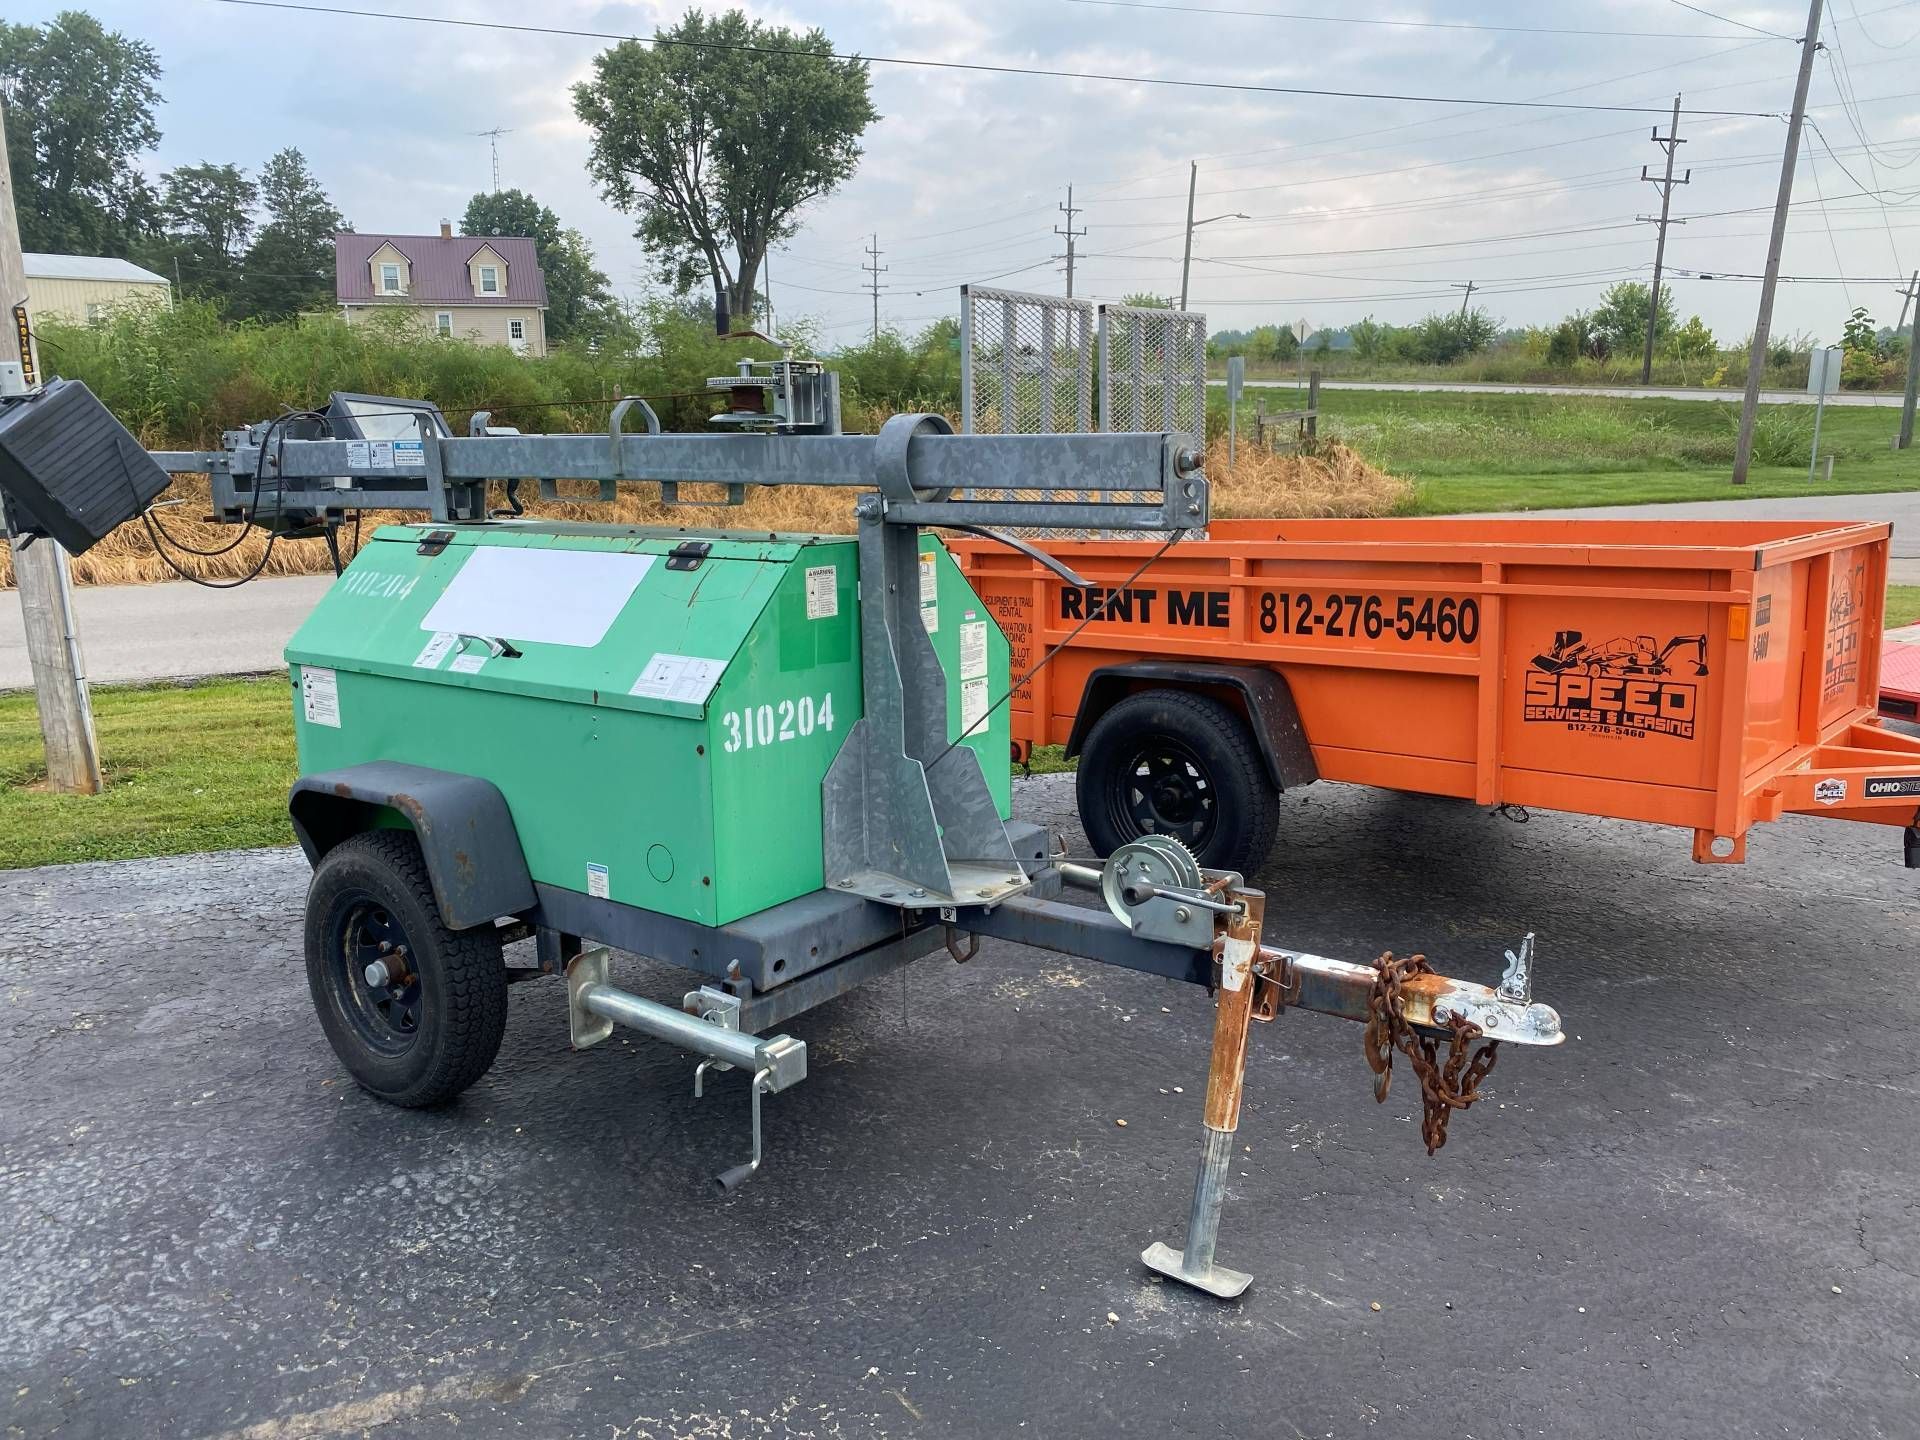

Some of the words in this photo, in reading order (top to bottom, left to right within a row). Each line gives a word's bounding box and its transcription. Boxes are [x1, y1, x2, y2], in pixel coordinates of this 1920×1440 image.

[998, 606, 1023, 618] RENTAL
[1061, 587, 1157, 623] RENT
[1167, 590, 1230, 628] ME
[1259, 591, 1480, 644] 812-276-5460
[1017, 647, 1032, 659] LOT
[1525, 671, 1697, 722] SPEED
[722, 692, 835, 753] 310204
[1525, 706, 1601, 723] SERVICES
[1622, 713, 1694, 738] LEASING
[1567, 722, 1646, 740] 812-276-5460
